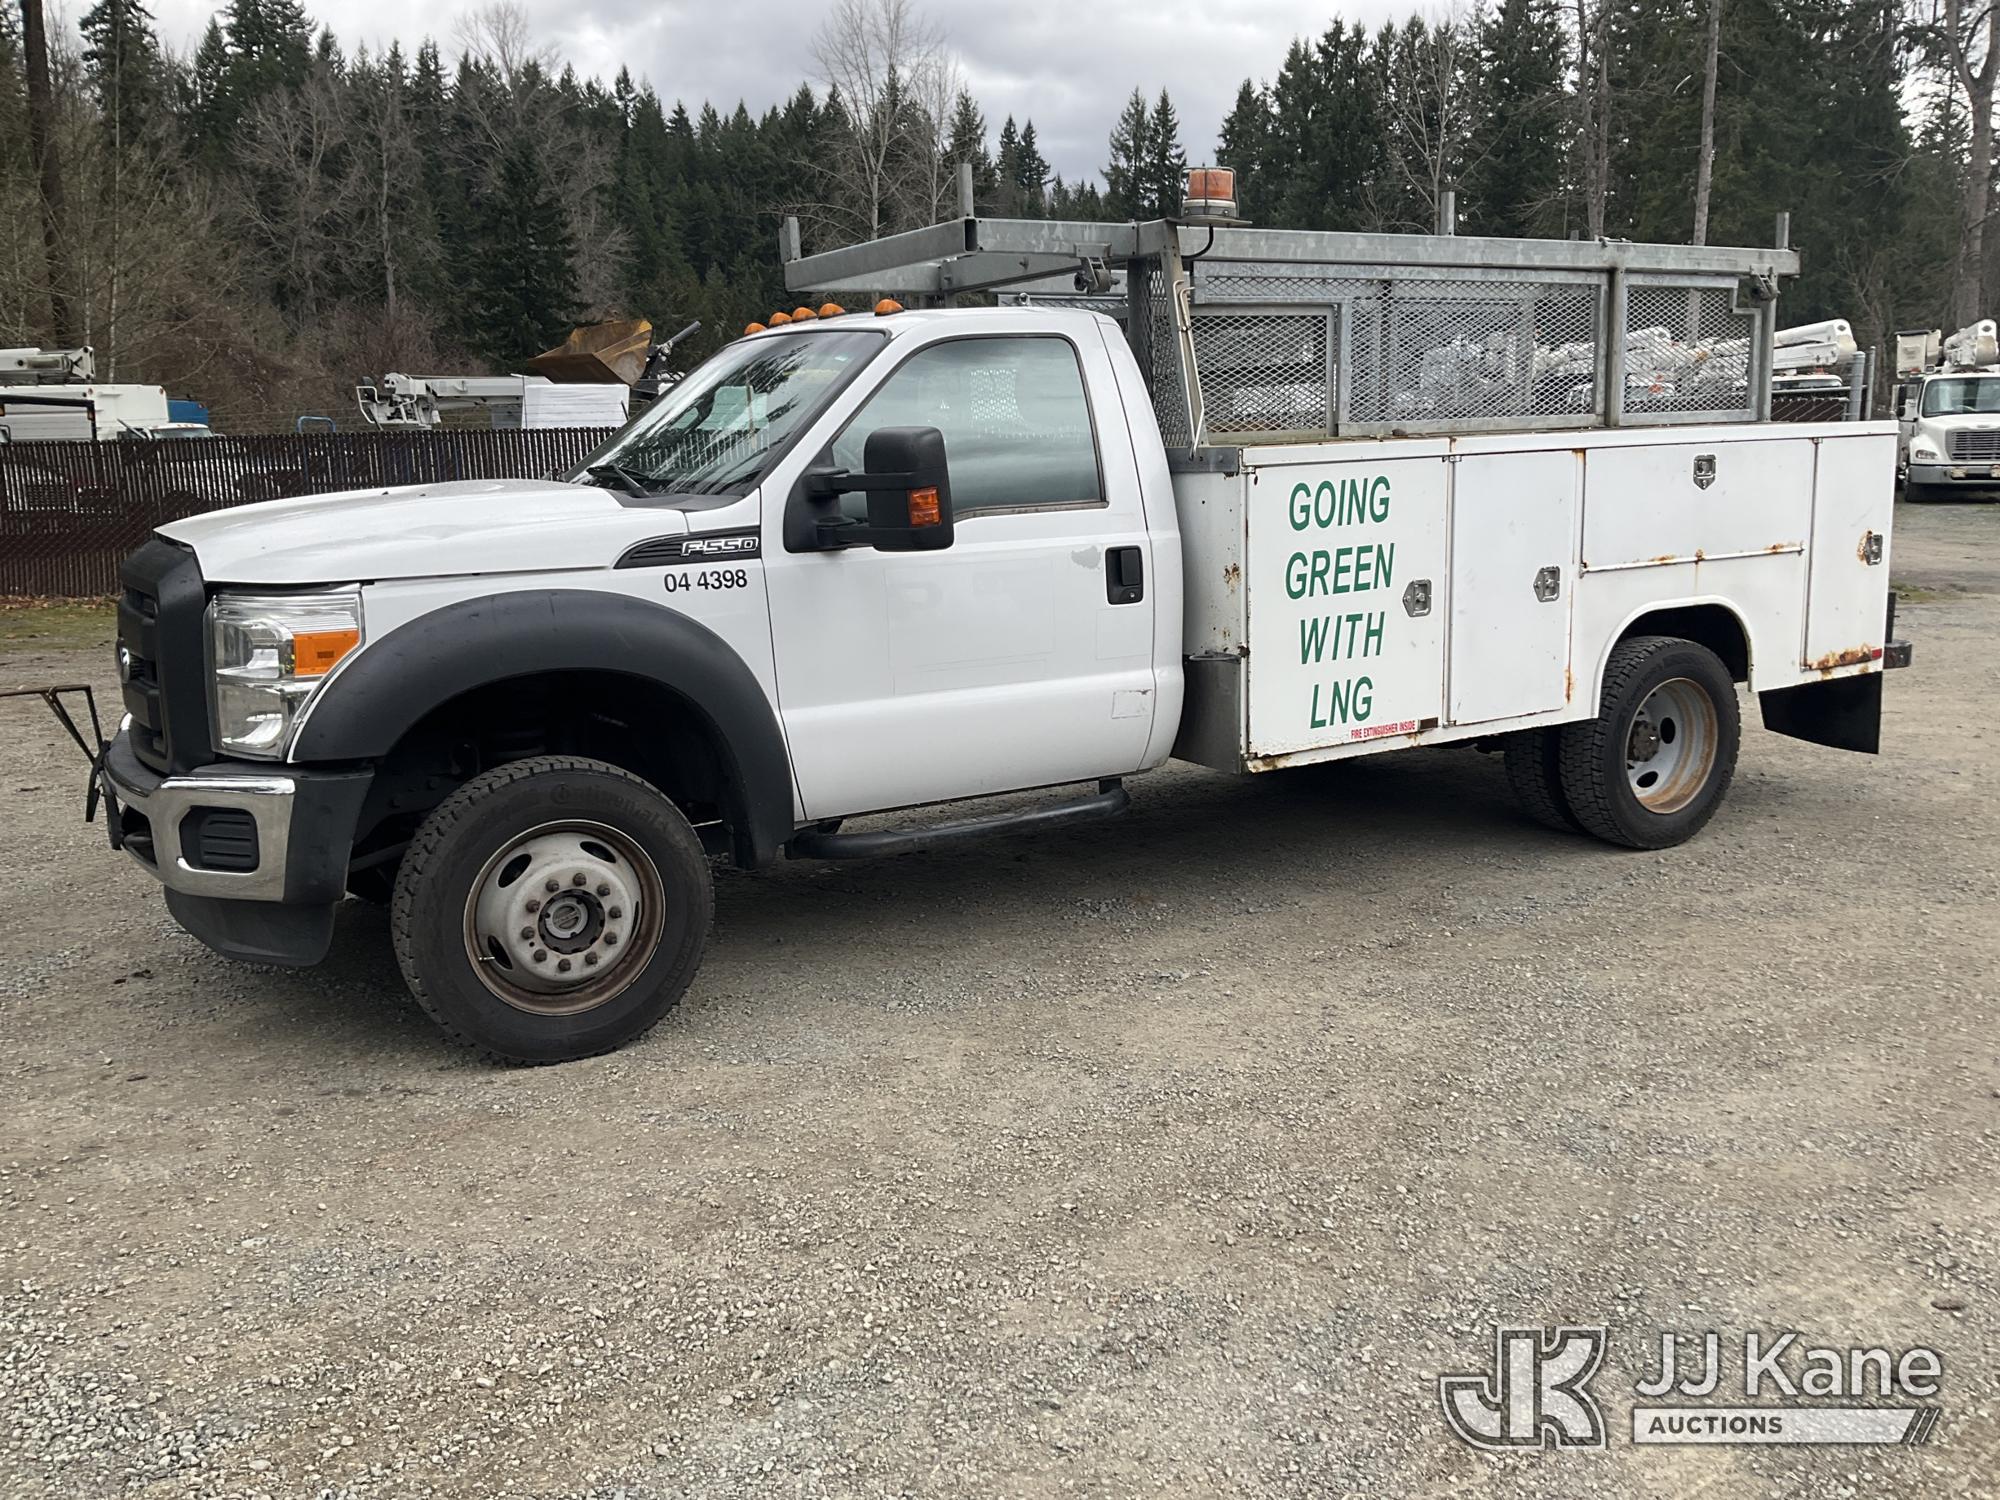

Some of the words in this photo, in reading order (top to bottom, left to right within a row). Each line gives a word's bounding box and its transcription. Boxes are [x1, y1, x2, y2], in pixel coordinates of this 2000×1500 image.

[1289, 475, 1391, 532] GOING
[681, 537, 758, 556] F-550
[1285, 542, 1395, 600] GREEN
[664, 572, 691, 593] 04
[697, 569, 748, 591] 4398
[1300, 611, 1385, 665] WITH
[1310, 676, 1373, 729] LNG
[1351, 728, 1362, 739] FIRE
[1363, 723, 1398, 737] EXTINGUISHER
[1399, 720, 1415, 731] INSIDE
